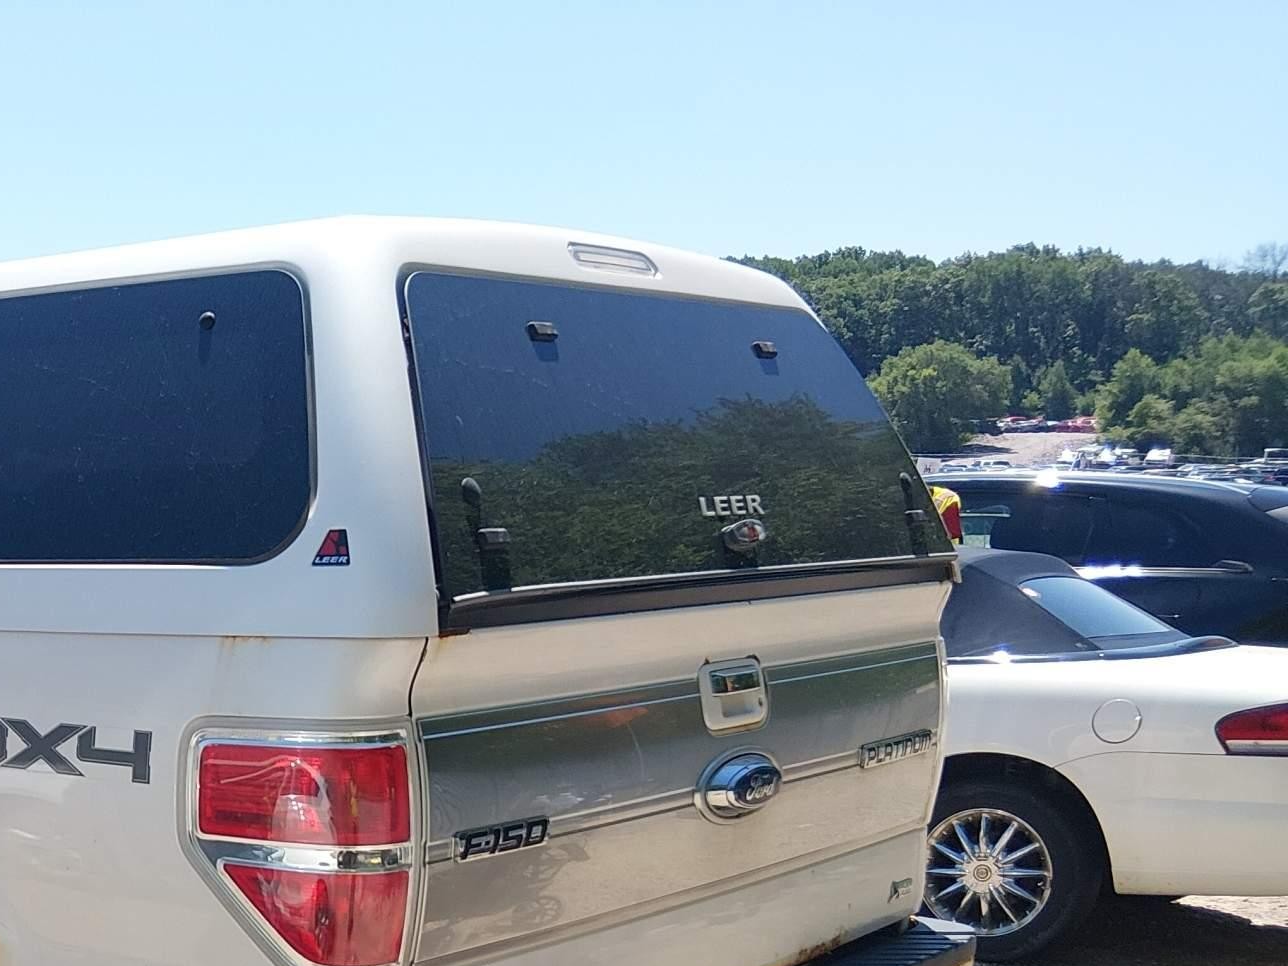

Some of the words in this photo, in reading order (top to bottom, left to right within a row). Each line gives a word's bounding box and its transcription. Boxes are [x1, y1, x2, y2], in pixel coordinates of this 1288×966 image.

[698, 494, 765, 517] LEER
[314, 555, 349, 564] LEER
[864, 731, 932, 767] PLATINUM
[745, 771, 778, 801] Ford
